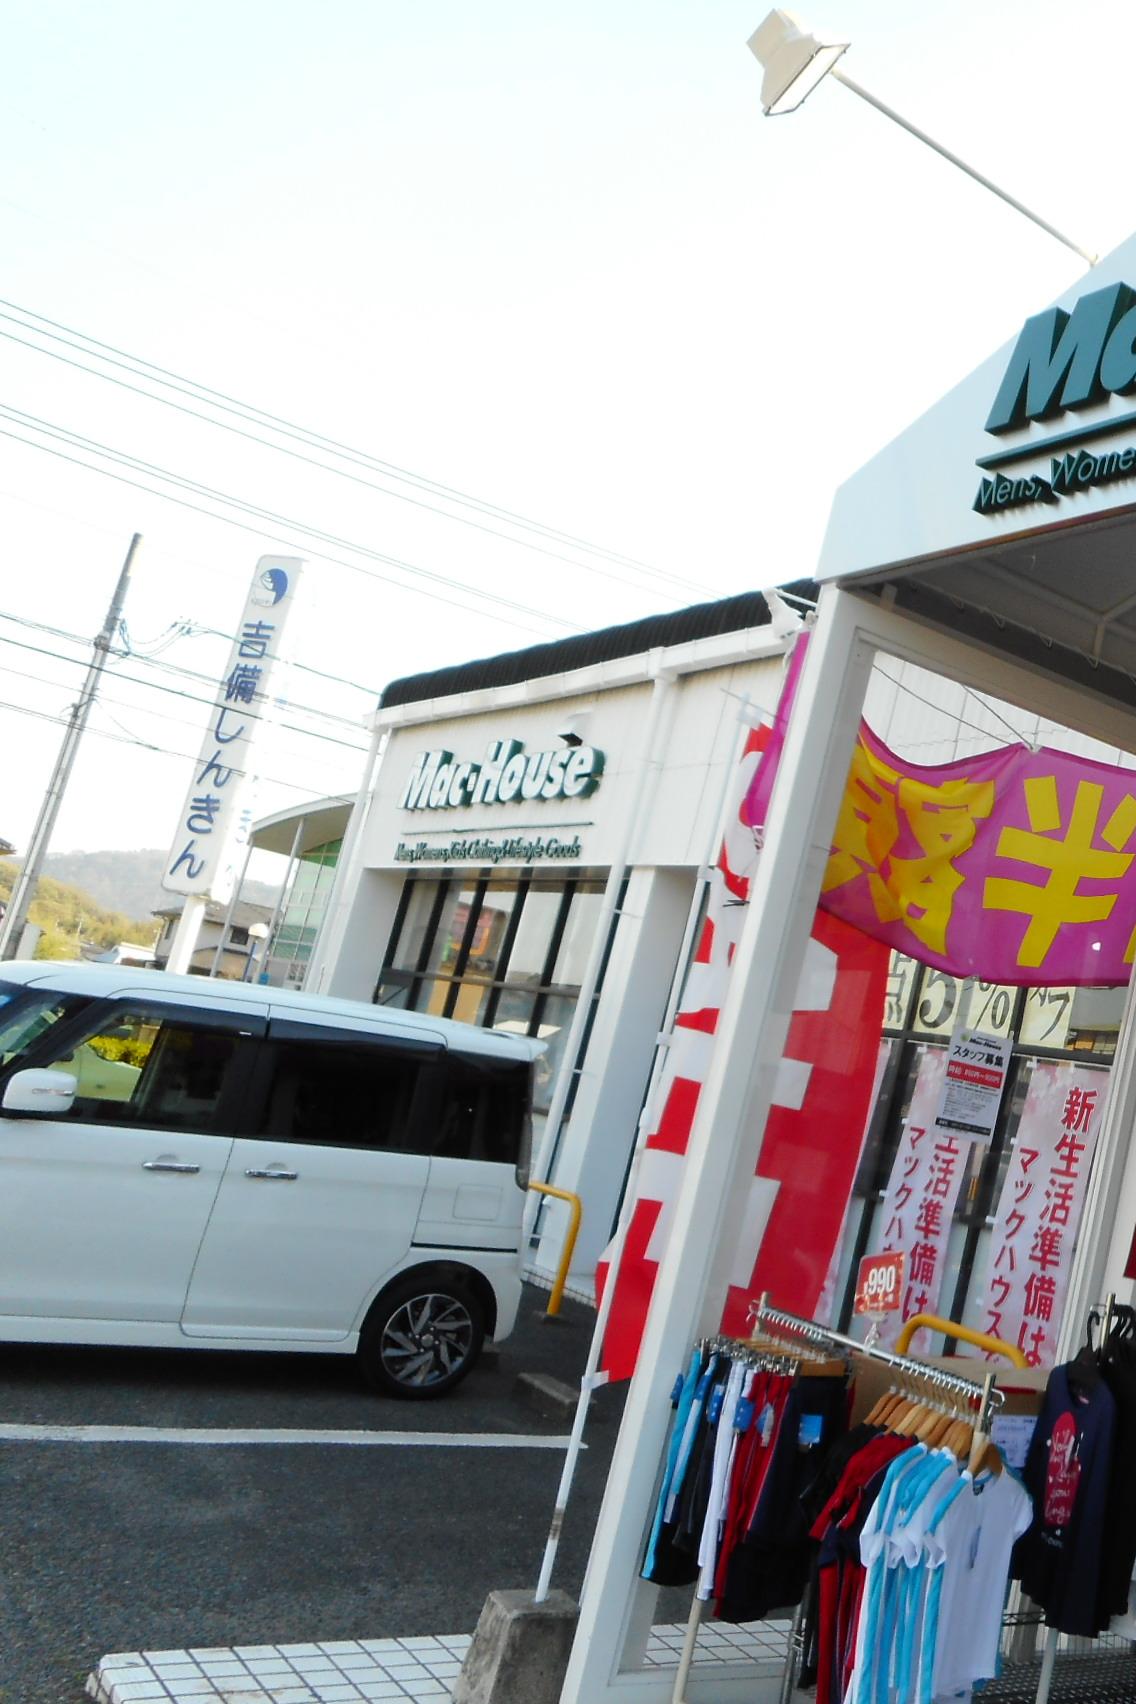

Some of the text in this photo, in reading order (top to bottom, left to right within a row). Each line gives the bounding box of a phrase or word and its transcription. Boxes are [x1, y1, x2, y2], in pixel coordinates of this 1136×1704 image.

[169, 620, 275, 880] 吉備しんきん
[398, 738, 606, 811] Mac-House
